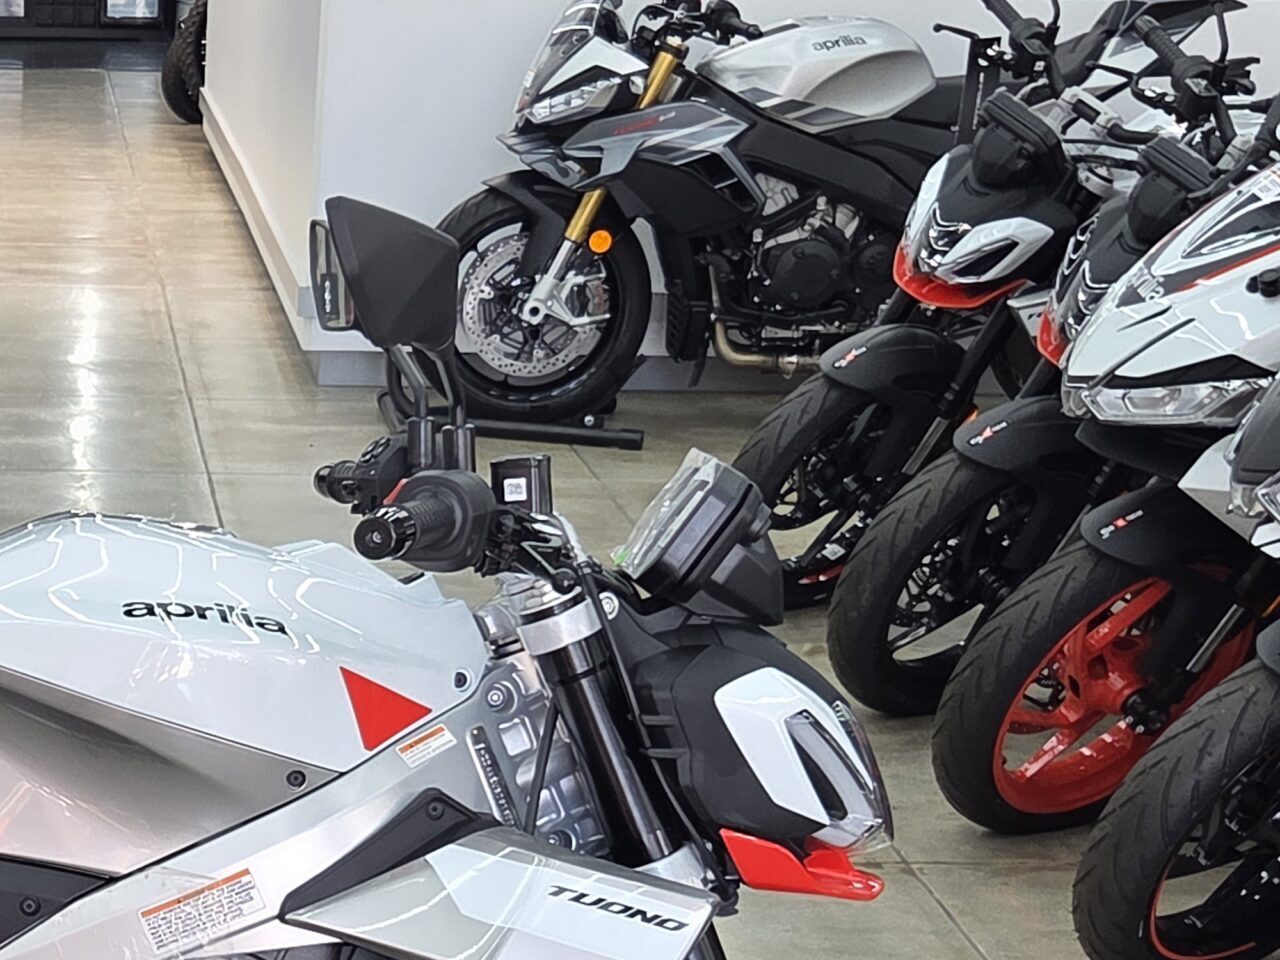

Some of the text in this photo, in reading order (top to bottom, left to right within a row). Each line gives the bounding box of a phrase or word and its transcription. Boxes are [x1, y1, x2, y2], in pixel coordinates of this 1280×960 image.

[811, 35, 867, 51] aprilia
[122, 601, 291, 637] aprilia
[547, 884, 690, 932] TUONO
